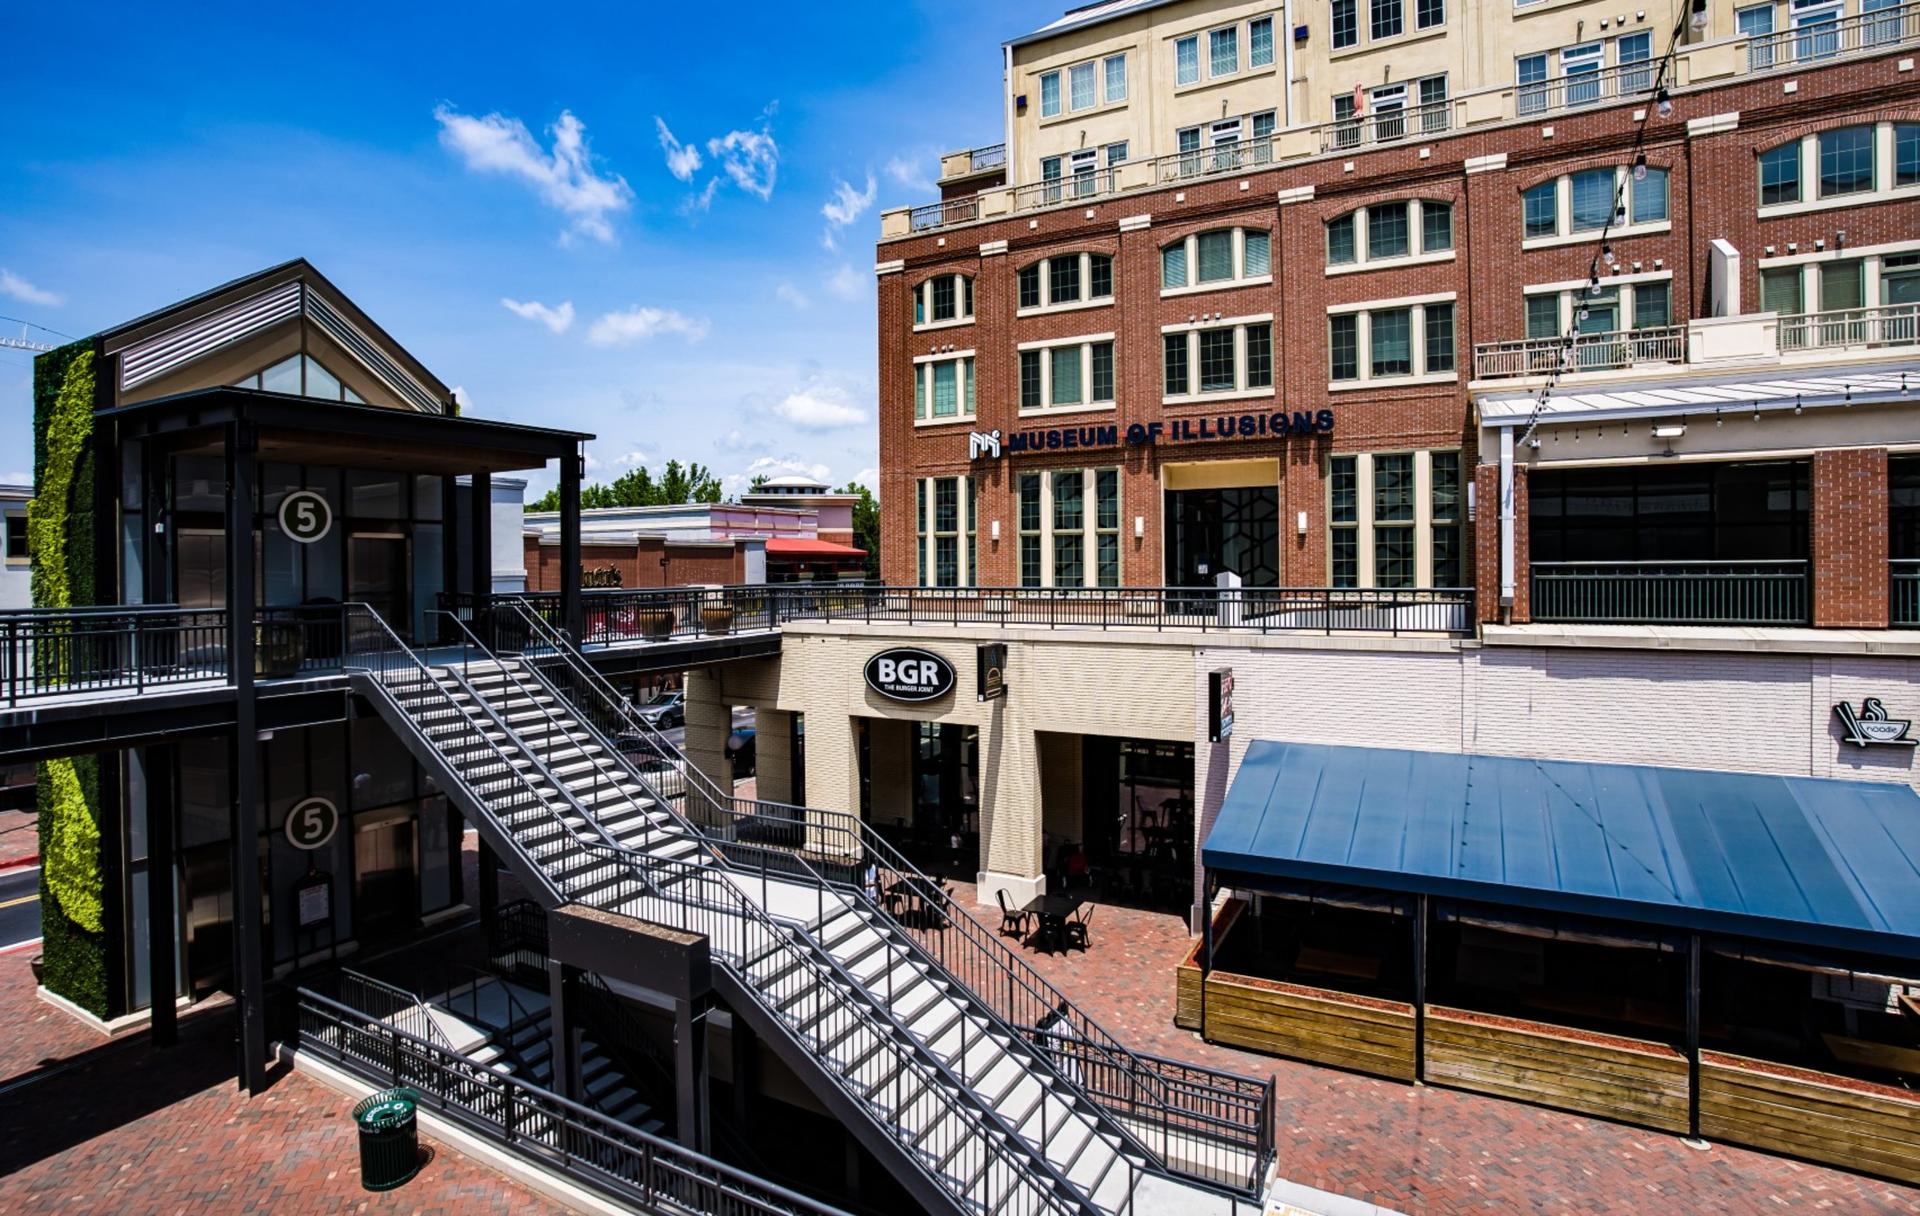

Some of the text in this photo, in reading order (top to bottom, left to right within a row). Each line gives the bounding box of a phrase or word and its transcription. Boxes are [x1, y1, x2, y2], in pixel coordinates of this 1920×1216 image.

[1008, 409, 1335, 450] MUSEUM OF ILLUSIONS
[297, 502, 316, 532] 5
[878, 658, 939, 685] BGR
[304, 807, 323, 839] 5
